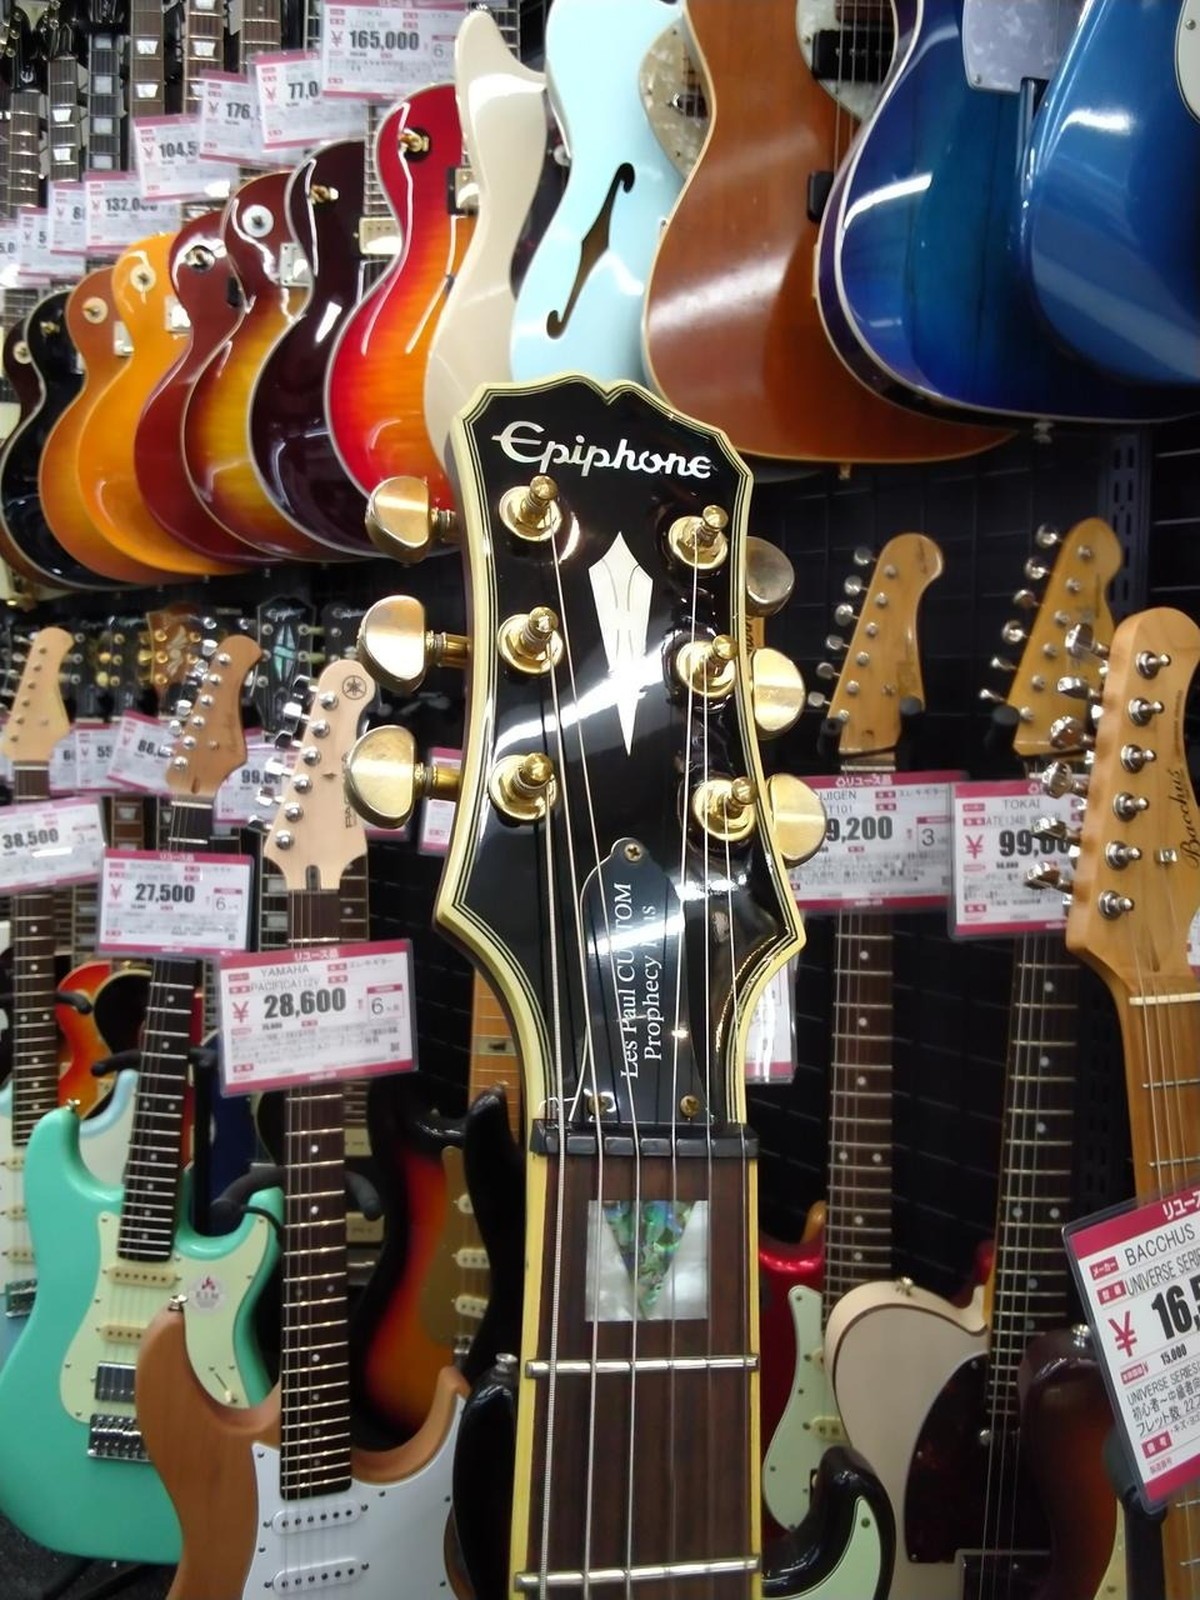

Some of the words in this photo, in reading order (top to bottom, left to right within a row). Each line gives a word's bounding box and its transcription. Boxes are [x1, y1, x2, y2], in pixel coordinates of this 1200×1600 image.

[350, 30, 420, 50] 165,000
[491, 420, 712, 479] Epiphone
[1003, 799, 1040, 811] TOKAI
[2, 827, 60, 850] 38,500
[921, 828, 936, 847] 3
[965, 835, 983, 859] ¥
[135, 883, 196, 903] 27,500
[215, 896, 227, 911] 6
[261, 964, 310, 978] YAMAHA
[232, 1001, 249, 1024] ¥
[264, 988, 347, 1020] 28,600
[371, 997, 385, 1016] 6
[618, 987, 638, 1034] Paul
[642, 955, 665, 1061] Prophecy
[620, 1040, 639, 1079] Les
[1124, 1223, 1196, 1267] BACCHUS
[1124, 1260, 1178, 1296] UNIVERSE
[1107, 1310, 1138, 1358] ¥
[1126, 1376, 1169, 1406] UNIVERSE
